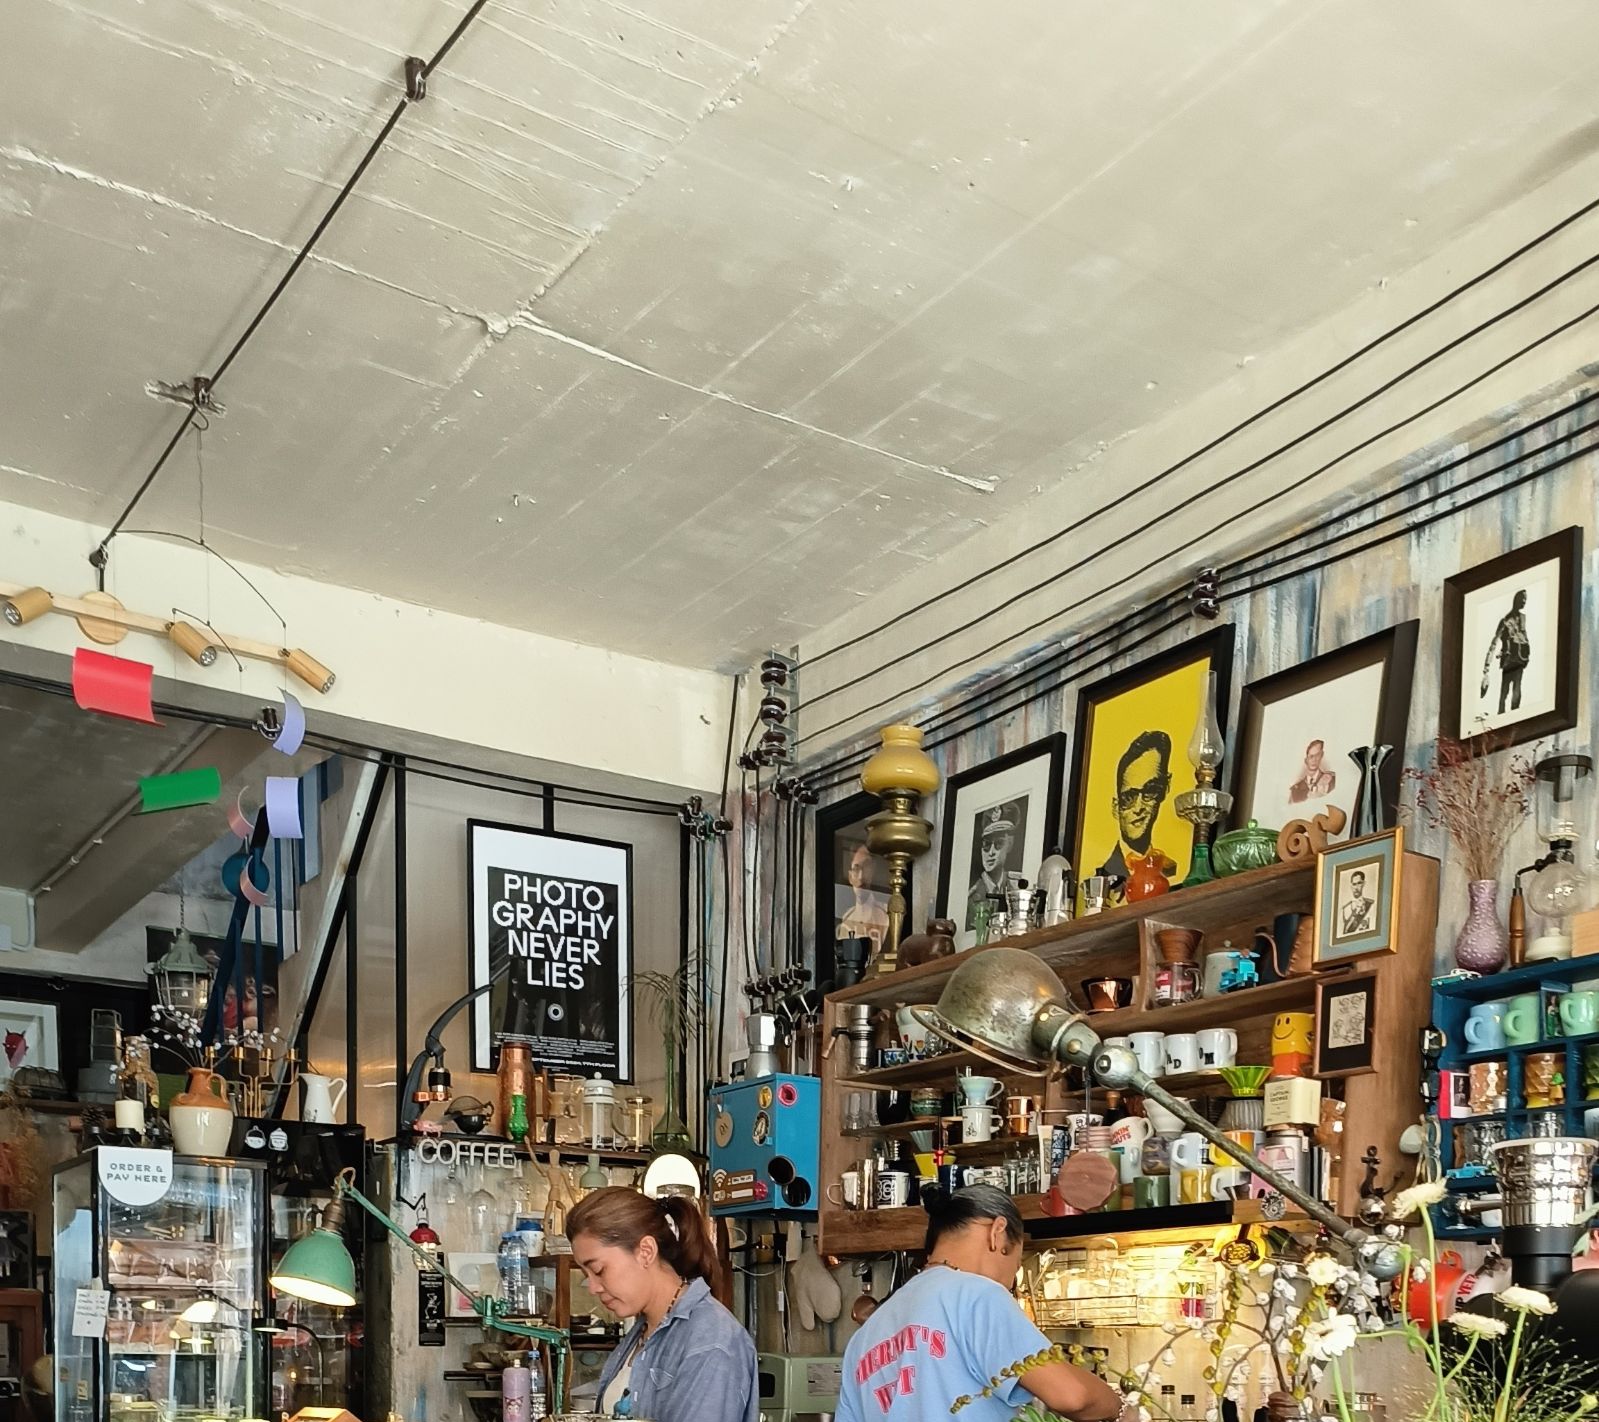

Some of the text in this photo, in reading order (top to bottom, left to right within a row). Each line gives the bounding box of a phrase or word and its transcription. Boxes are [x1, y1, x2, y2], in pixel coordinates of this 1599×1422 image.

[503, 873, 605, 911] PHOTO
[492, 901, 614, 939] GRAPHY
[507, 929, 601, 966] NEVER
[526, 959, 584, 990] LIES
[110, 1162, 151, 1172] ORDER
[419, 1138, 516, 1168] COFFEE
[106, 1173, 167, 1183] PAY HERE
